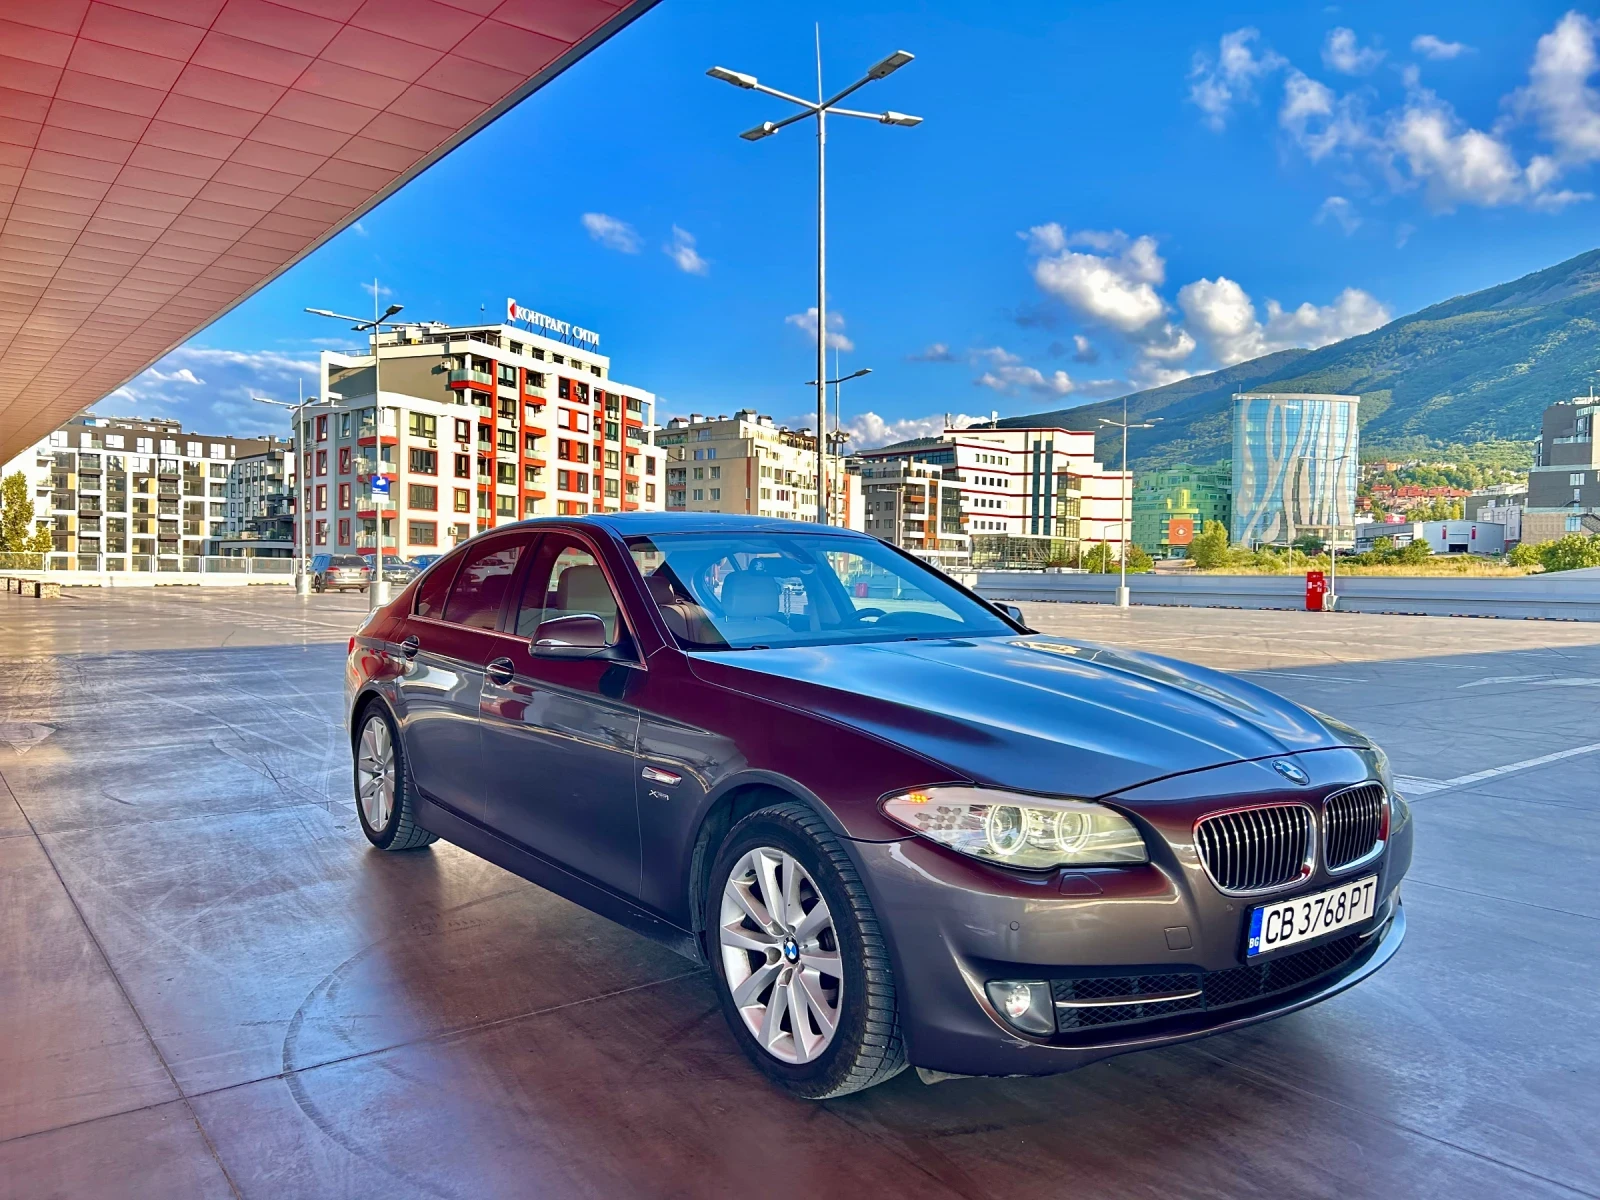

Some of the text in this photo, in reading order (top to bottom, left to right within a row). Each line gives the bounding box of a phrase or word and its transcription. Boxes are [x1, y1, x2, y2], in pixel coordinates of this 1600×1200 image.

[516, 304, 600, 346] КОНТРАКТ СИТИ
[1265, 882, 1373, 944] CB 3768 PT
[1249, 936, 1260, 949] BG
